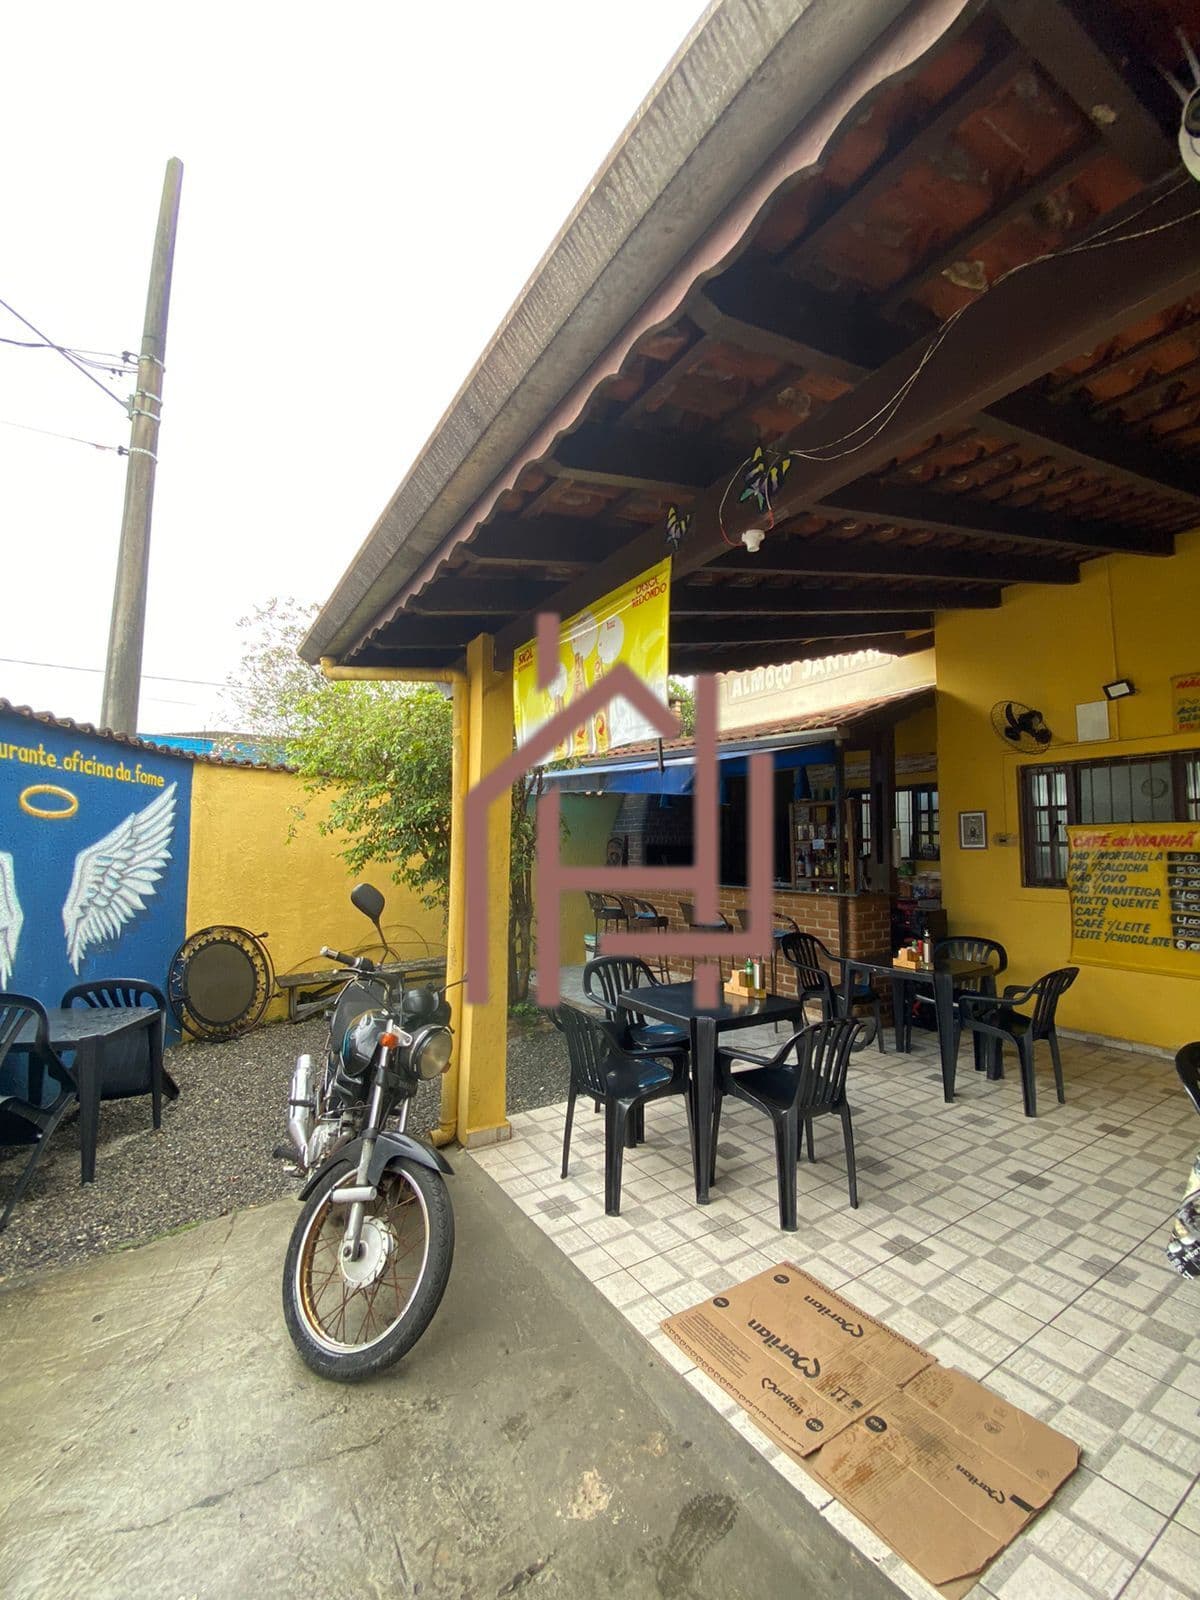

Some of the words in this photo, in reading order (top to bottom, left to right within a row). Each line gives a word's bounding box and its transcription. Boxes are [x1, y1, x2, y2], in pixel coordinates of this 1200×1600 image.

[631, 582, 667, 608] REDONDO
[731, 663, 792, 698] ALMOÇO
[1127, 830, 1197, 848] MANHÃ
[1073, 895, 1109, 906] MIXTO
[1112, 897, 1160, 909] QUENTE
[1075, 906, 1106, 917] CAFÉ
[1074, 917, 1106, 928] CAFÉ
[1073, 929, 1103, 939] LEITE
[803, 1294, 864, 1338] Marilan
[747, 1318, 821, 1379] Marilan
[761, 1377, 804, 1416] Marilan
